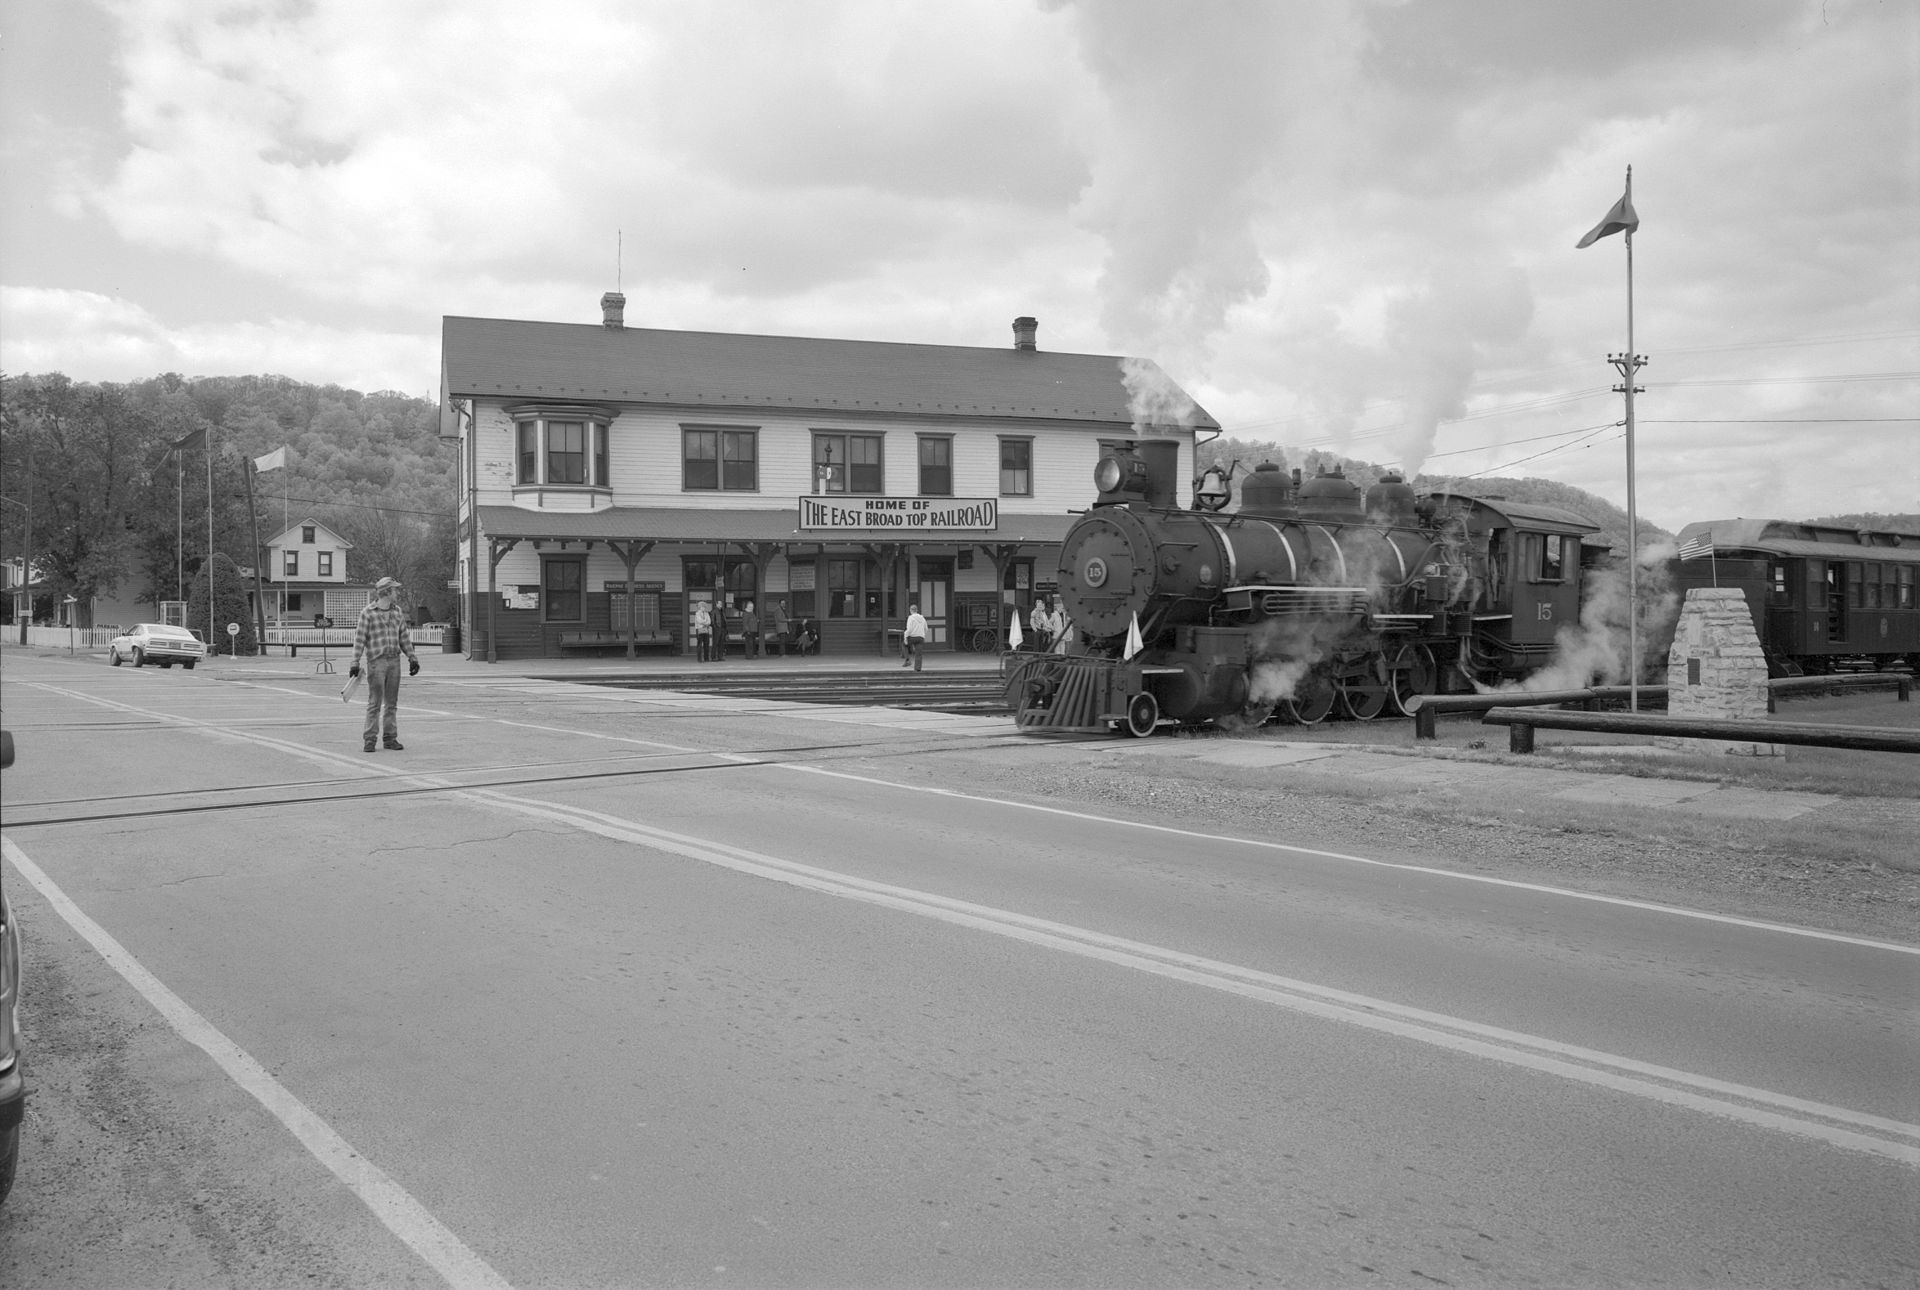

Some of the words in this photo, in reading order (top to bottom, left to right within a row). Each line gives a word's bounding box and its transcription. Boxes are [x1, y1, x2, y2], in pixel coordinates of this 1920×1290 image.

[1134, 462, 1145, 473] 15
[865, 500, 906, 510] HOME
[912, 500, 930, 510] OF
[804, 499, 828, 526] THE
[831, 507, 862, 526] EAST
[865, 512, 903, 526] BROAD
[906, 513, 927, 526] TOP
[930, 501, 994, 527] RAILROAD
[1089, 567, 1101, 577] 15
[1537, 602, 1552, 620] 15
